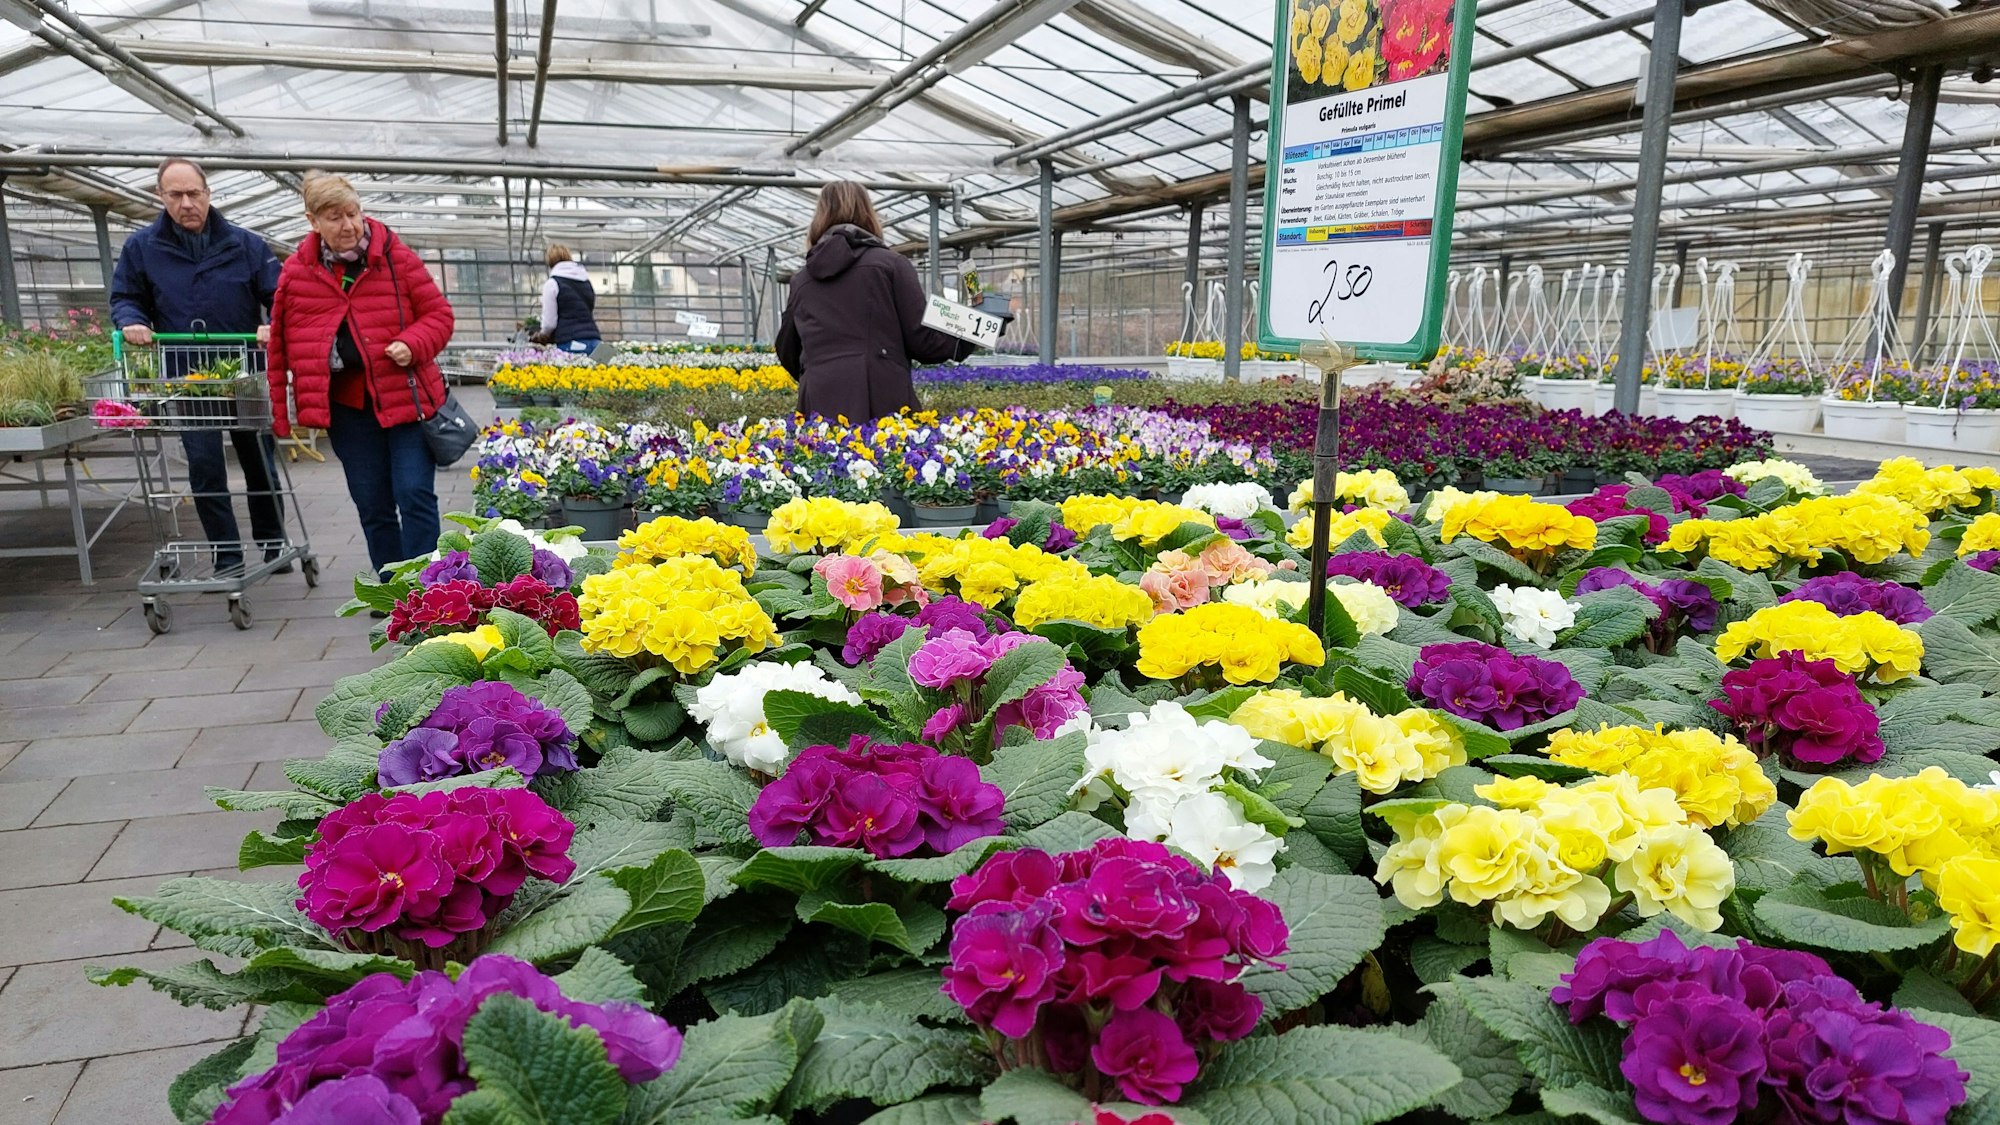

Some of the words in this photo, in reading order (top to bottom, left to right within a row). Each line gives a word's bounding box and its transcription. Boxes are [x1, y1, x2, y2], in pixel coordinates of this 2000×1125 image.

[1319, 101, 1364, 122] Gefüllte
[1366, 90, 1407, 113] Primel
[1359, 122, 1376, 131] vulgaris
[1343, 158, 1356, 167] schon
[1356, 157, 1362, 165] ab
[1363, 155, 1386, 164] Dezember
[1387, 152, 1407, 160] blühend
[1341, 180, 1355, 188] feucht
[1372, 177, 1384, 185] nicht
[1384, 174, 1414, 184] austrocknen
[1324, 192, 1345, 200] Staunässe
[1345, 189, 1368, 198] vermeiden
[1364, 199, 1389, 207] Exemplare
[1389, 196, 1399, 204] sind
[1400, 195, 1426, 204] winterhart
[1391, 208, 1405, 217] Tröge
[972, 316, 998, 340] 1,99
